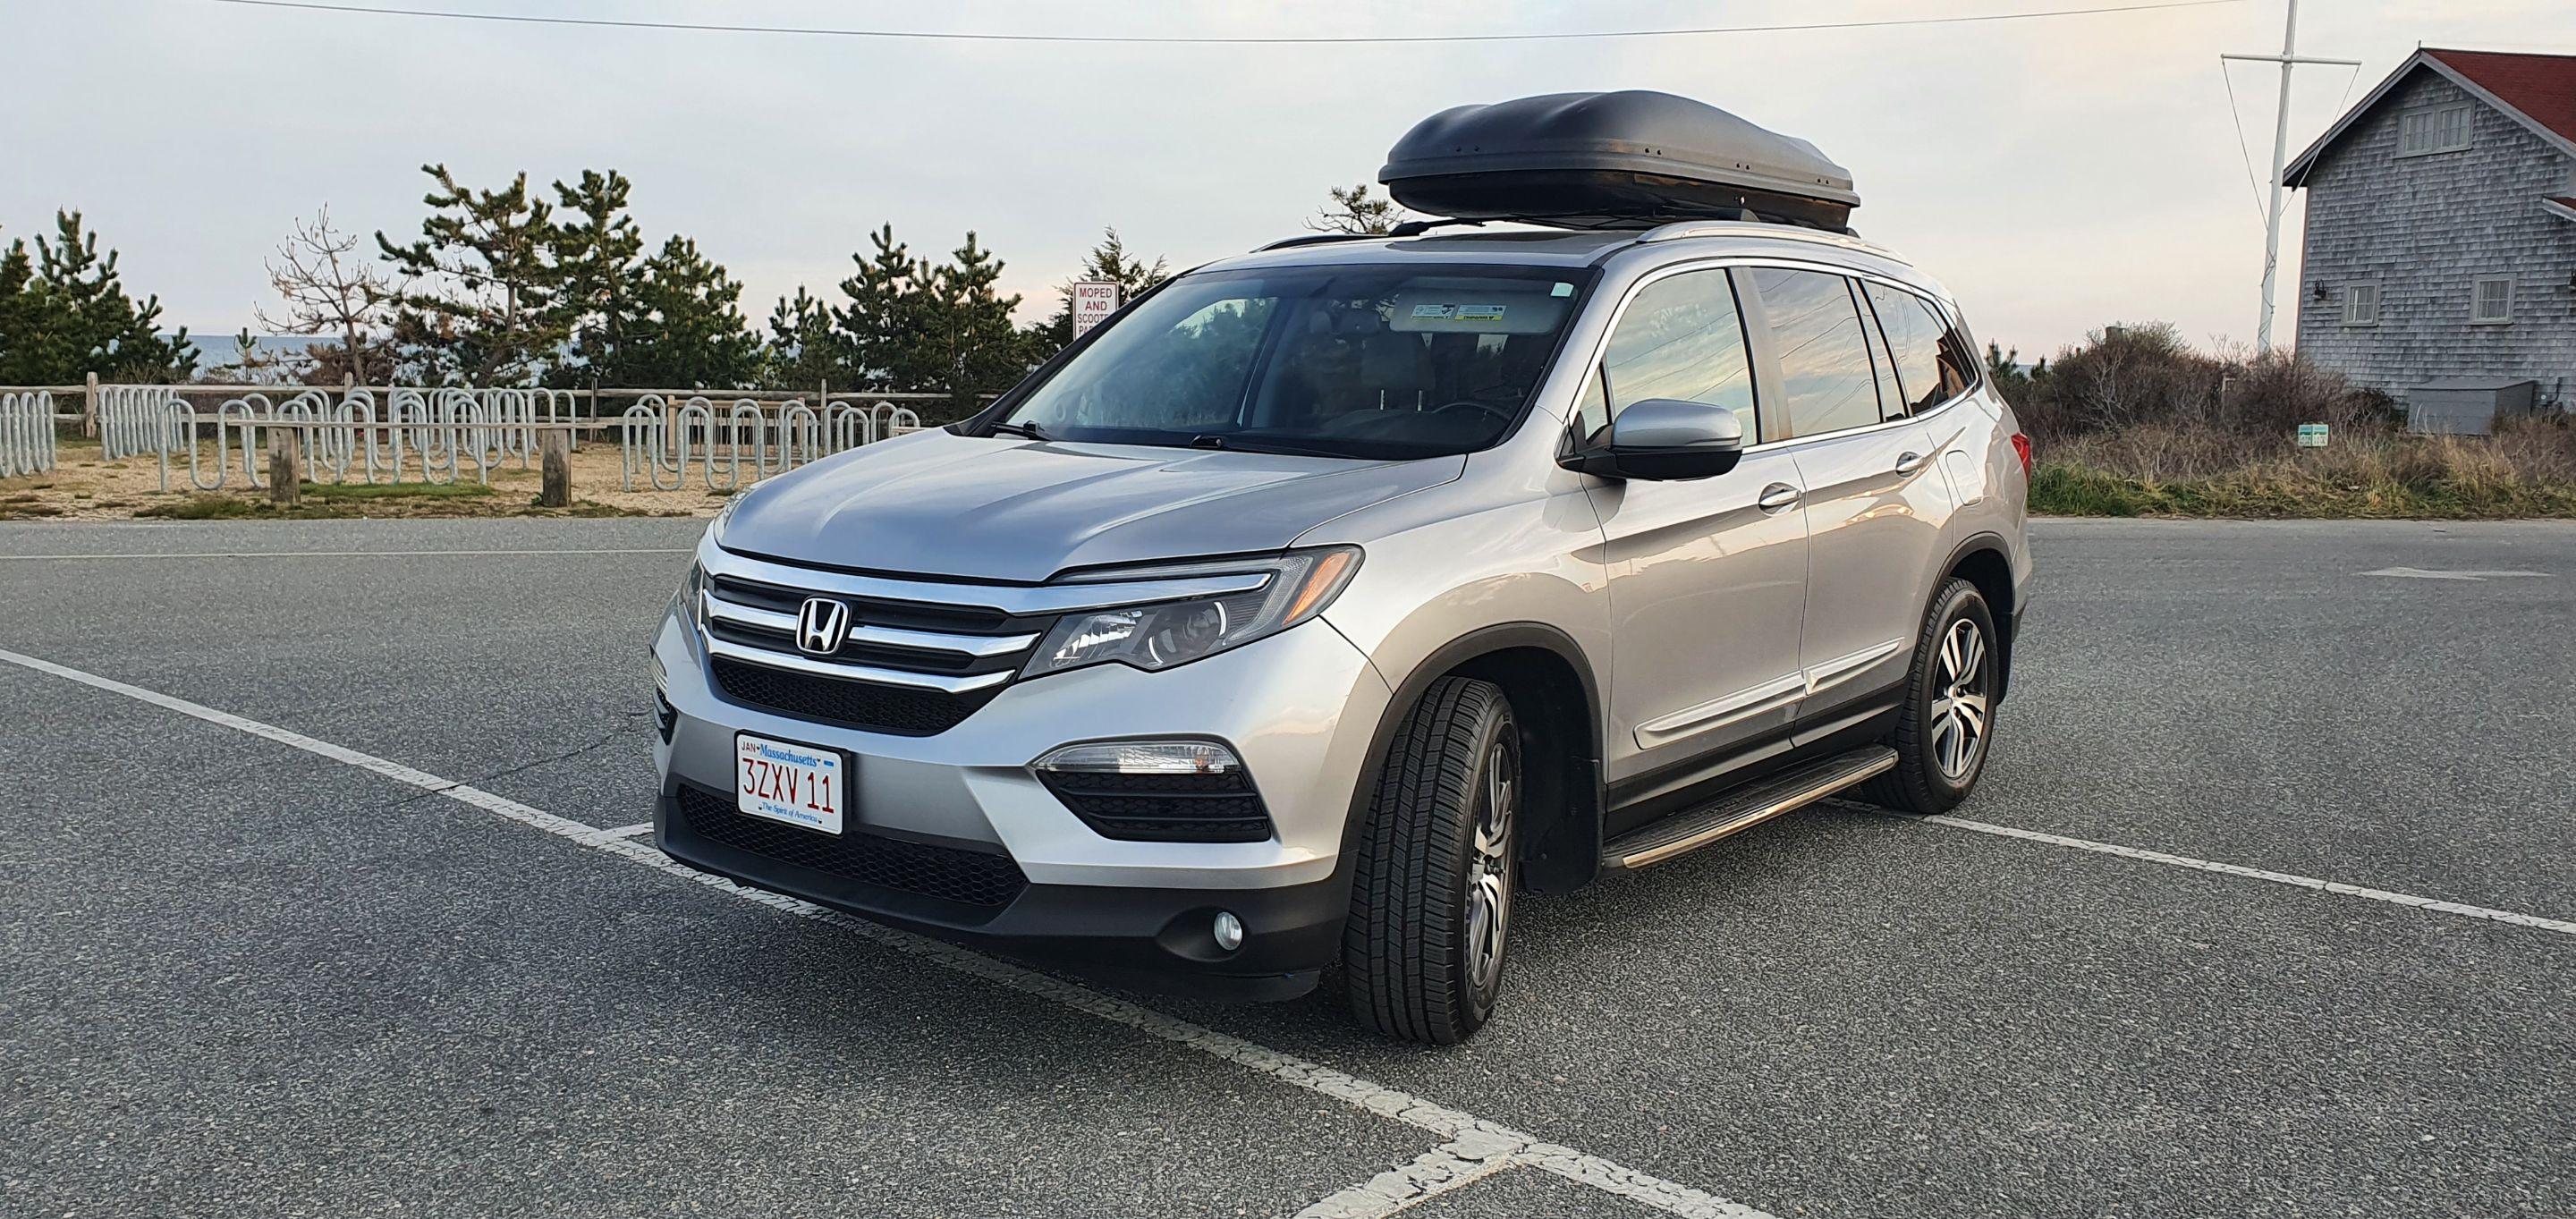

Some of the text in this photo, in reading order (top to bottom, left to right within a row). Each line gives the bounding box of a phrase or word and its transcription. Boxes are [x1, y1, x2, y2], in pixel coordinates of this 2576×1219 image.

[1080, 288, 1113, 298] MOPED
[1085, 301, 1107, 311] AND
[741, 741, 756, 753] JAN
[759, 743, 818, 767] Massachusetts
[742, 758, 835, 814] 3ZXV 11
[762, 801, 818, 822] The Spirit of America
